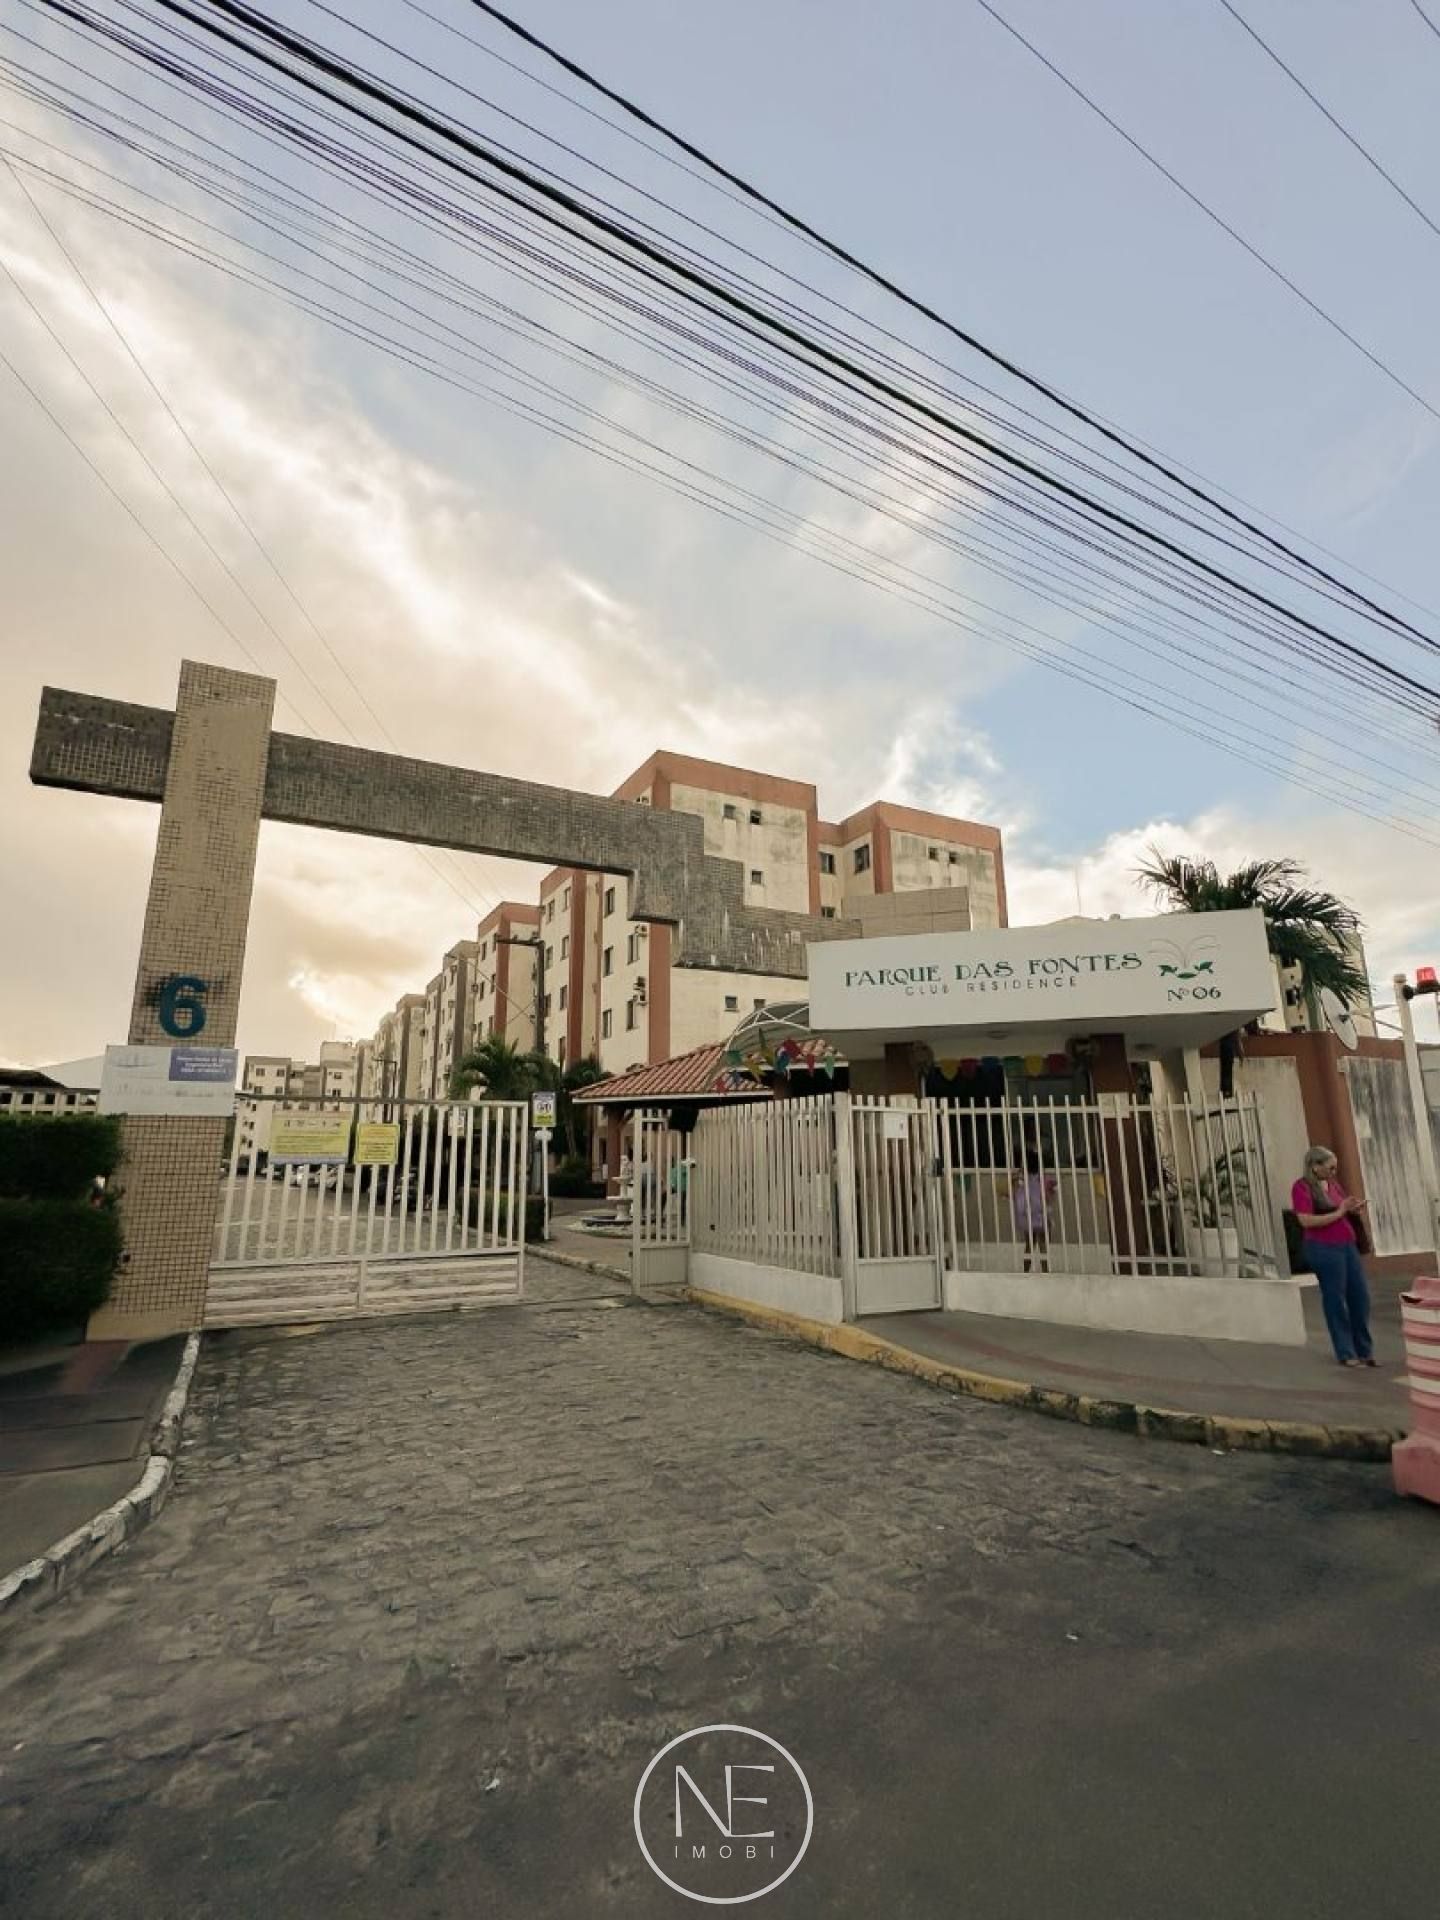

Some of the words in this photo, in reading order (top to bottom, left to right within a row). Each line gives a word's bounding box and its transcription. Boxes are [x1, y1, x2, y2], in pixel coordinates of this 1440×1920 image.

[845, 964, 942, 988] PARQUE
[955, 961, 1014, 980] DAS
[1028, 953, 1143, 975] FONTES
[904, 984, 950, 996] CLUB
[966, 976, 1077, 993] RESIDENCE
[160, 976, 207, 1038] 6
